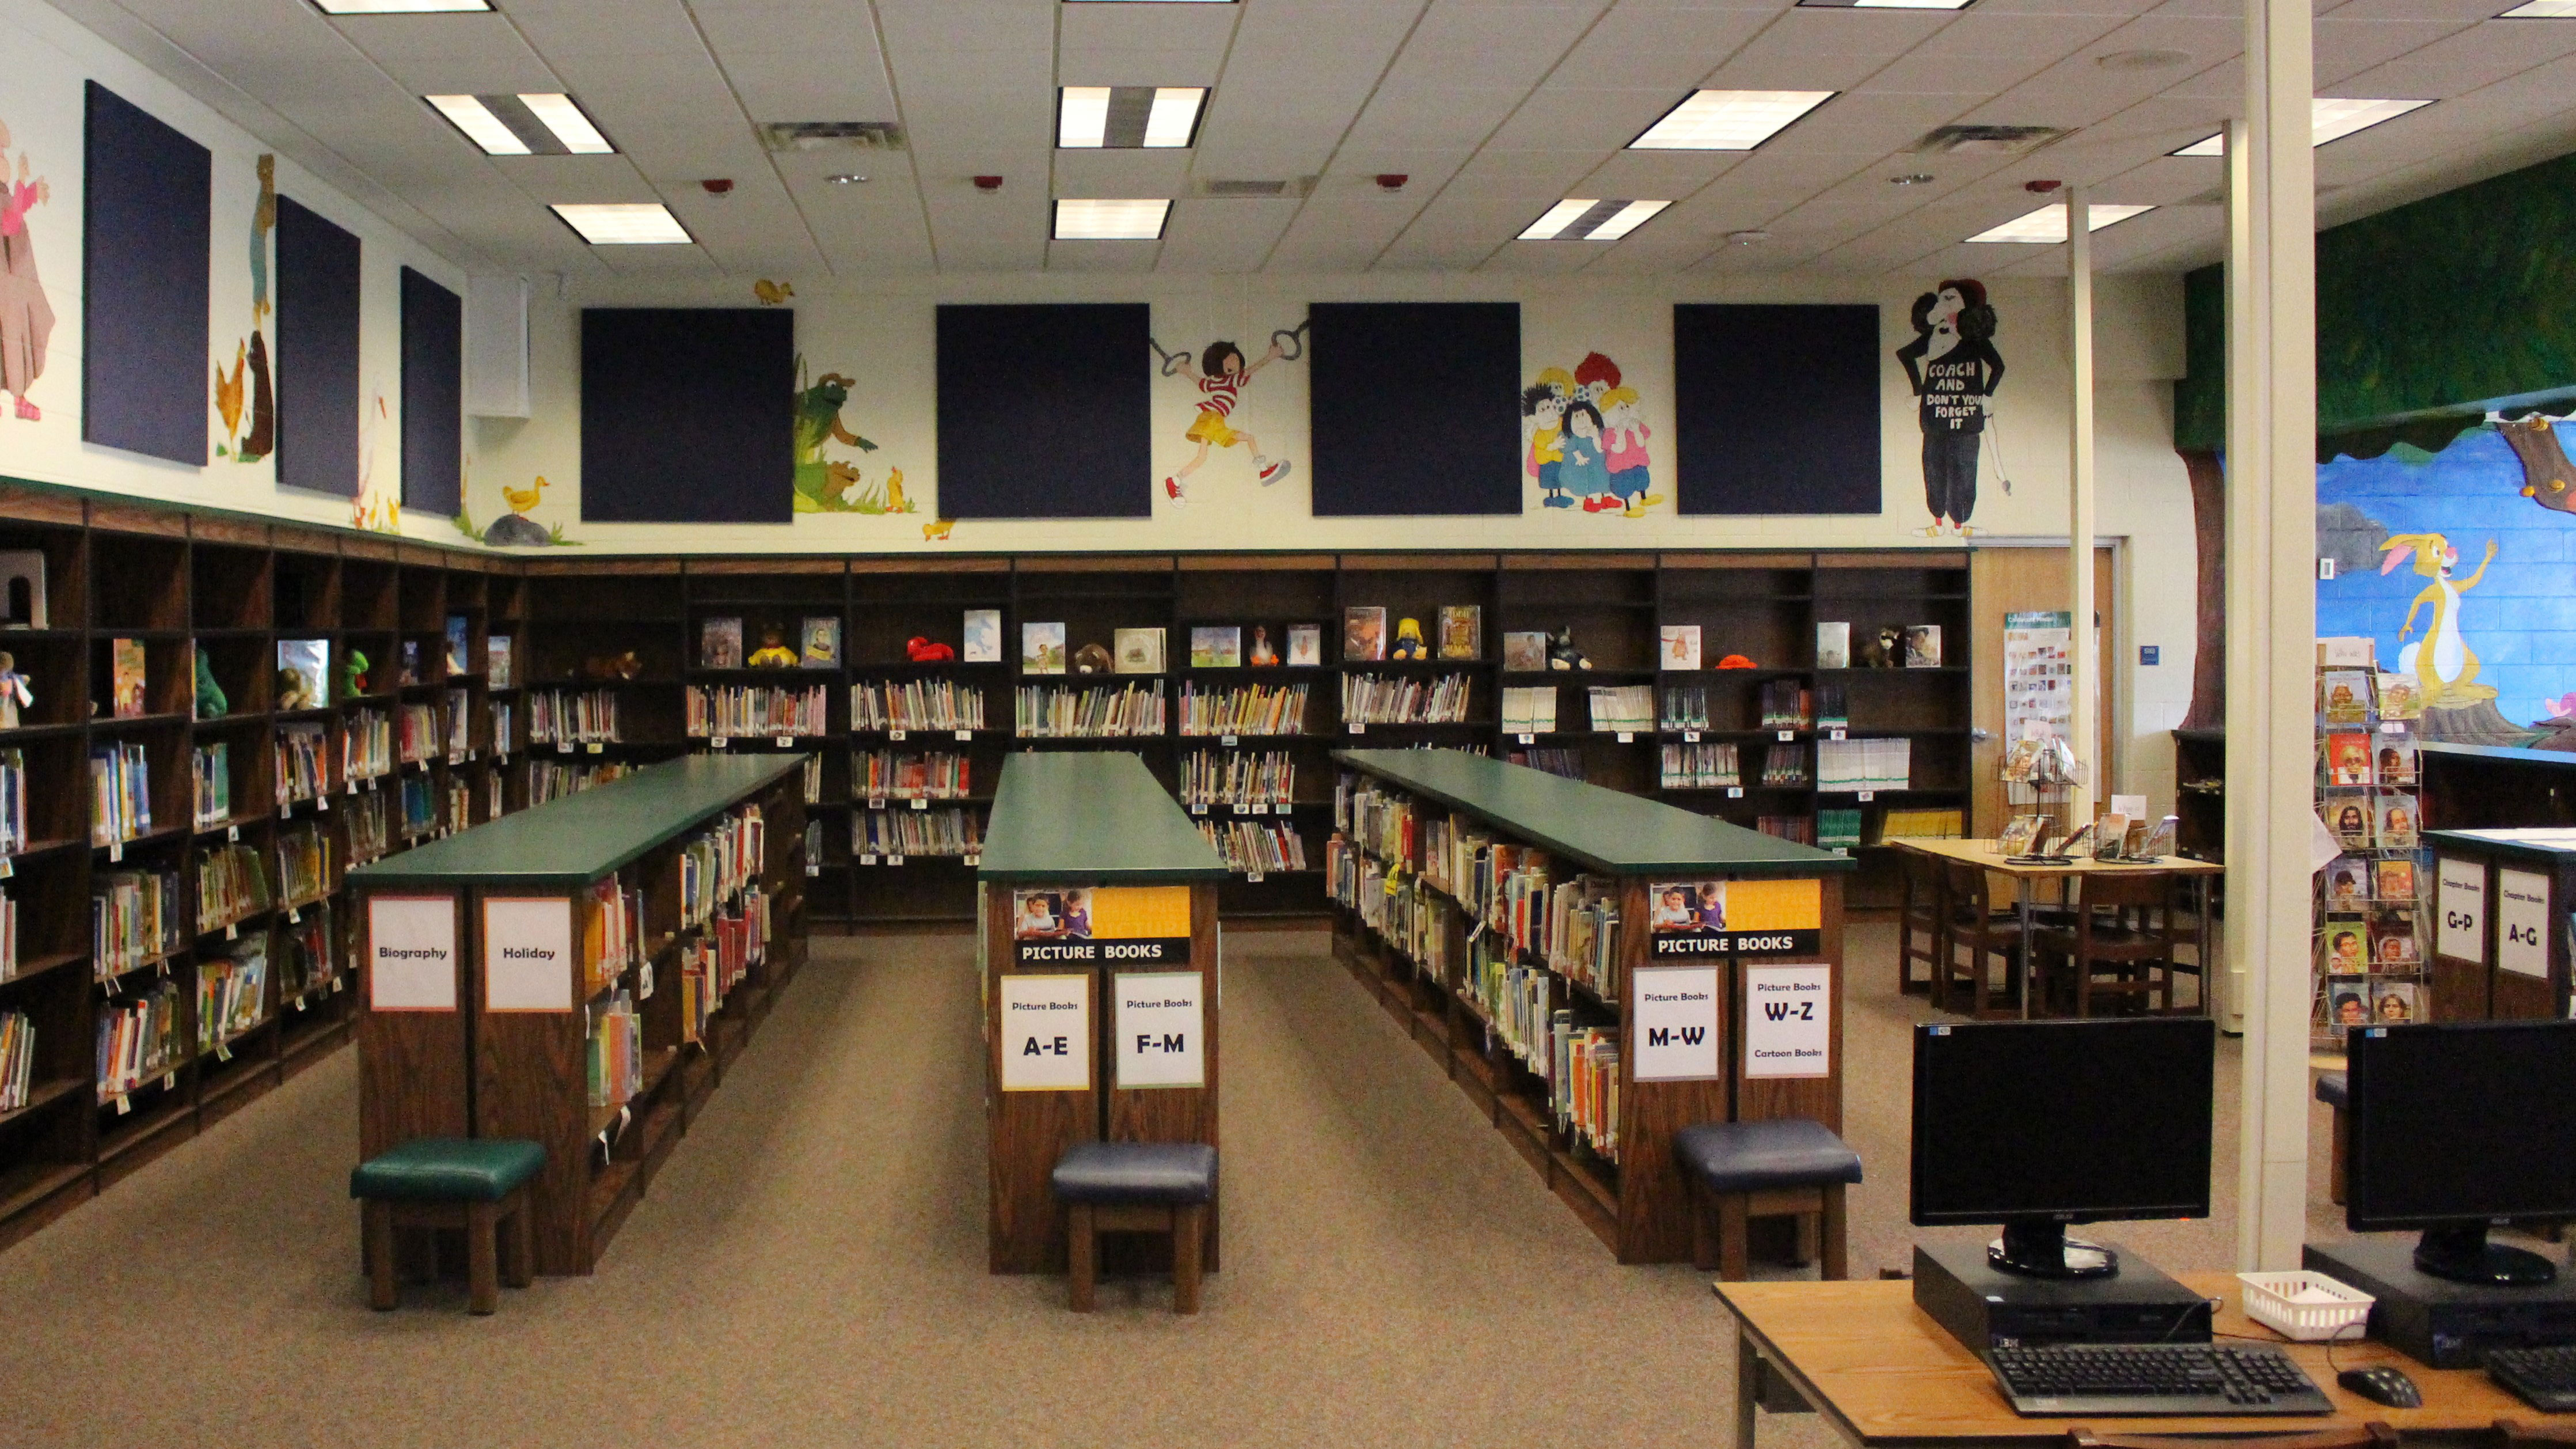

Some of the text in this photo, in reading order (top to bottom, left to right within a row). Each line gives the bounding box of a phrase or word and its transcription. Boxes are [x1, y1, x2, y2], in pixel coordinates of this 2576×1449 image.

[1929, 362, 1975, 377] COACH
[1935, 379, 1965, 390] AND
[1927, 394, 1982, 405] DON'T YOU
[1935, 406, 1976, 418] FORGET
[1950, 419, 1963, 429] IT
[2448, 911, 2472, 931] G-P
[2509, 924, 2537, 946] A-G
[1659, 936, 1794, 953] PICTURE BOOKS
[379, 947, 447, 960] Biography
[503, 947, 555, 960] Holiday
[1023, 944, 1162, 959] PICTURE BOOKS
[1757, 983, 1821, 992] Picture Books
[1127, 999, 1192, 1008] Picture Books
[1644, 992, 1708, 1002] Picture Books
[1012, 1002, 1078, 1010] Picture Books
[1765, 1002, 1813, 1021] W-Z
[1649, 1027, 1705, 1046] M-W
[1023, 1037, 1067, 1056] A-E
[1137, 1034, 1184, 1053] F-M
[1754, 1048, 1822, 1057] Cartoon Books
